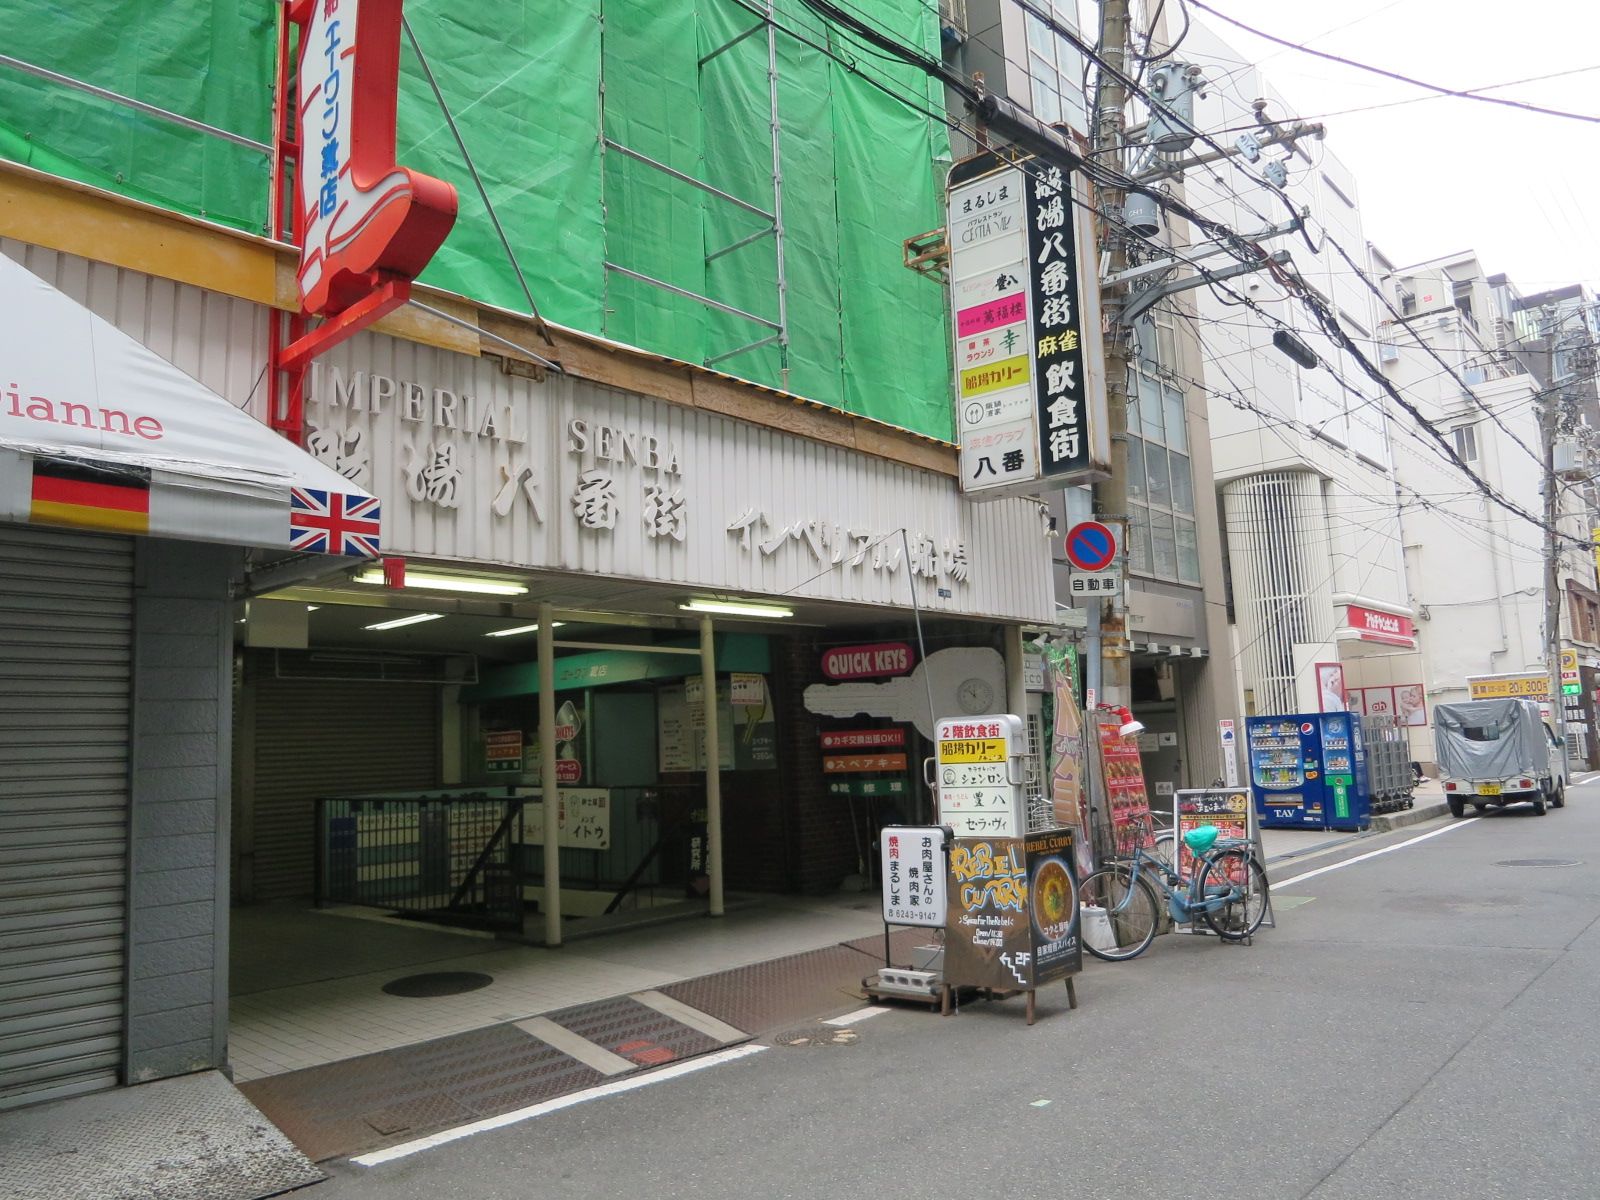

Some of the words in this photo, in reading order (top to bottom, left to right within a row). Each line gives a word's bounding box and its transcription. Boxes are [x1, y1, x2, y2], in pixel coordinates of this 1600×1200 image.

[962, 186, 1008, 213] まるしま
[966, 348, 995, 362] ラウンジ
[1038, 329, 1079, 359] 麻雀
[965, 366, 1022, 390] 船場カリー
[0, 383, 163, 440] ianne
[307, 361, 529, 444] IMPERIAL
[568, 419, 683, 477] SENBA
[1045, 360, 1079, 463] 飲食街
[973, 449, 1025, 479] 八番
[1073, 578, 1115, 591] 自動車
[828, 652, 872, 676] QUICK
[875, 649, 908, 671] KEYS
[942, 724, 999, 738] 2階飲食街
[941, 741, 997, 755] 船場カリー
[836, 758, 901, 769] スペアキー
[961, 775, 1004, 785] シェンロン
[573, 825, 604, 840] イトウ
[966, 818, 1007, 831] セ・ラ・ヴィ
[1026, 839, 1048, 853] REBEL
[1049, 836, 1073, 849] CURRY
[922, 836, 934, 905] お肉屋さんの
[950, 841, 1027, 883] REBEL
[908, 867, 920, 906] 焼肉家
[960, 877, 1028, 913] CURRY
[896, 909, 936, 921] 6243-9147
[1015, 952, 1031, 966] 2F
